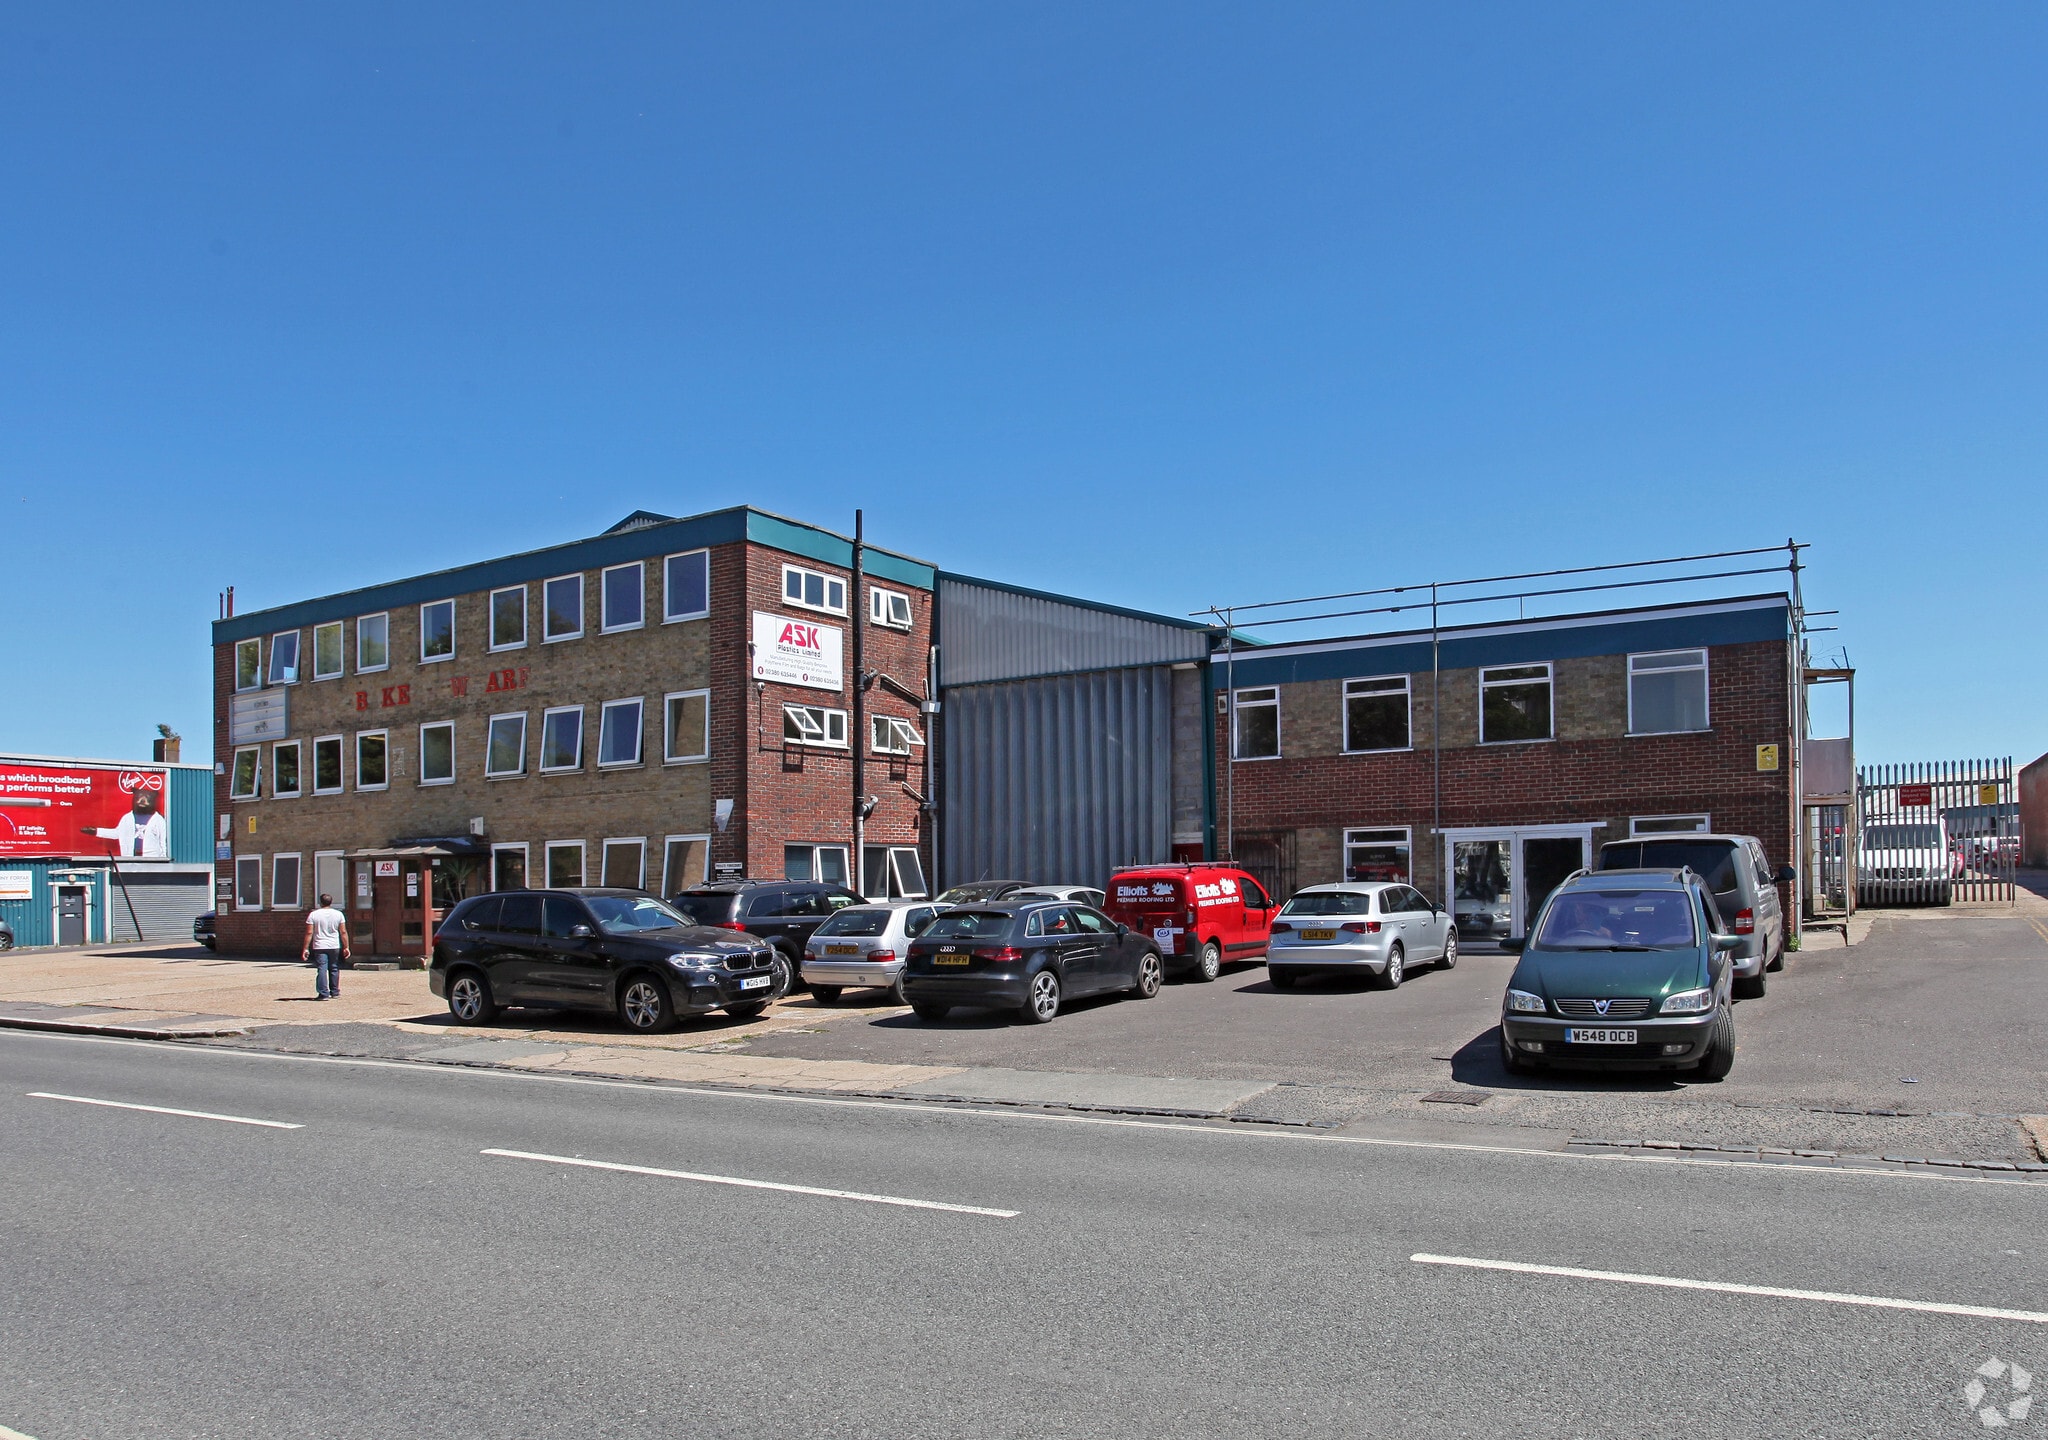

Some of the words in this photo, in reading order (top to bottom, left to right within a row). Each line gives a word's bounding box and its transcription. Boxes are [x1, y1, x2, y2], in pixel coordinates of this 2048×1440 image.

[778, 622, 820, 650] ASK
[778, 644, 800, 654] Plastics
[7, 774, 37, 782] which
[38, 775, 91, 784] broadband
[6, 784, 52, 792] performs
[54, 785, 92, 794] better?
[380, 863, 394, 872] ASK
[1117, 886, 1148, 896] Elliotts
[1194, 883, 1220, 898] Elliotts
[1573, 1030, 1606, 1042] W548
[1609, 1030, 1634, 1042] OCB
